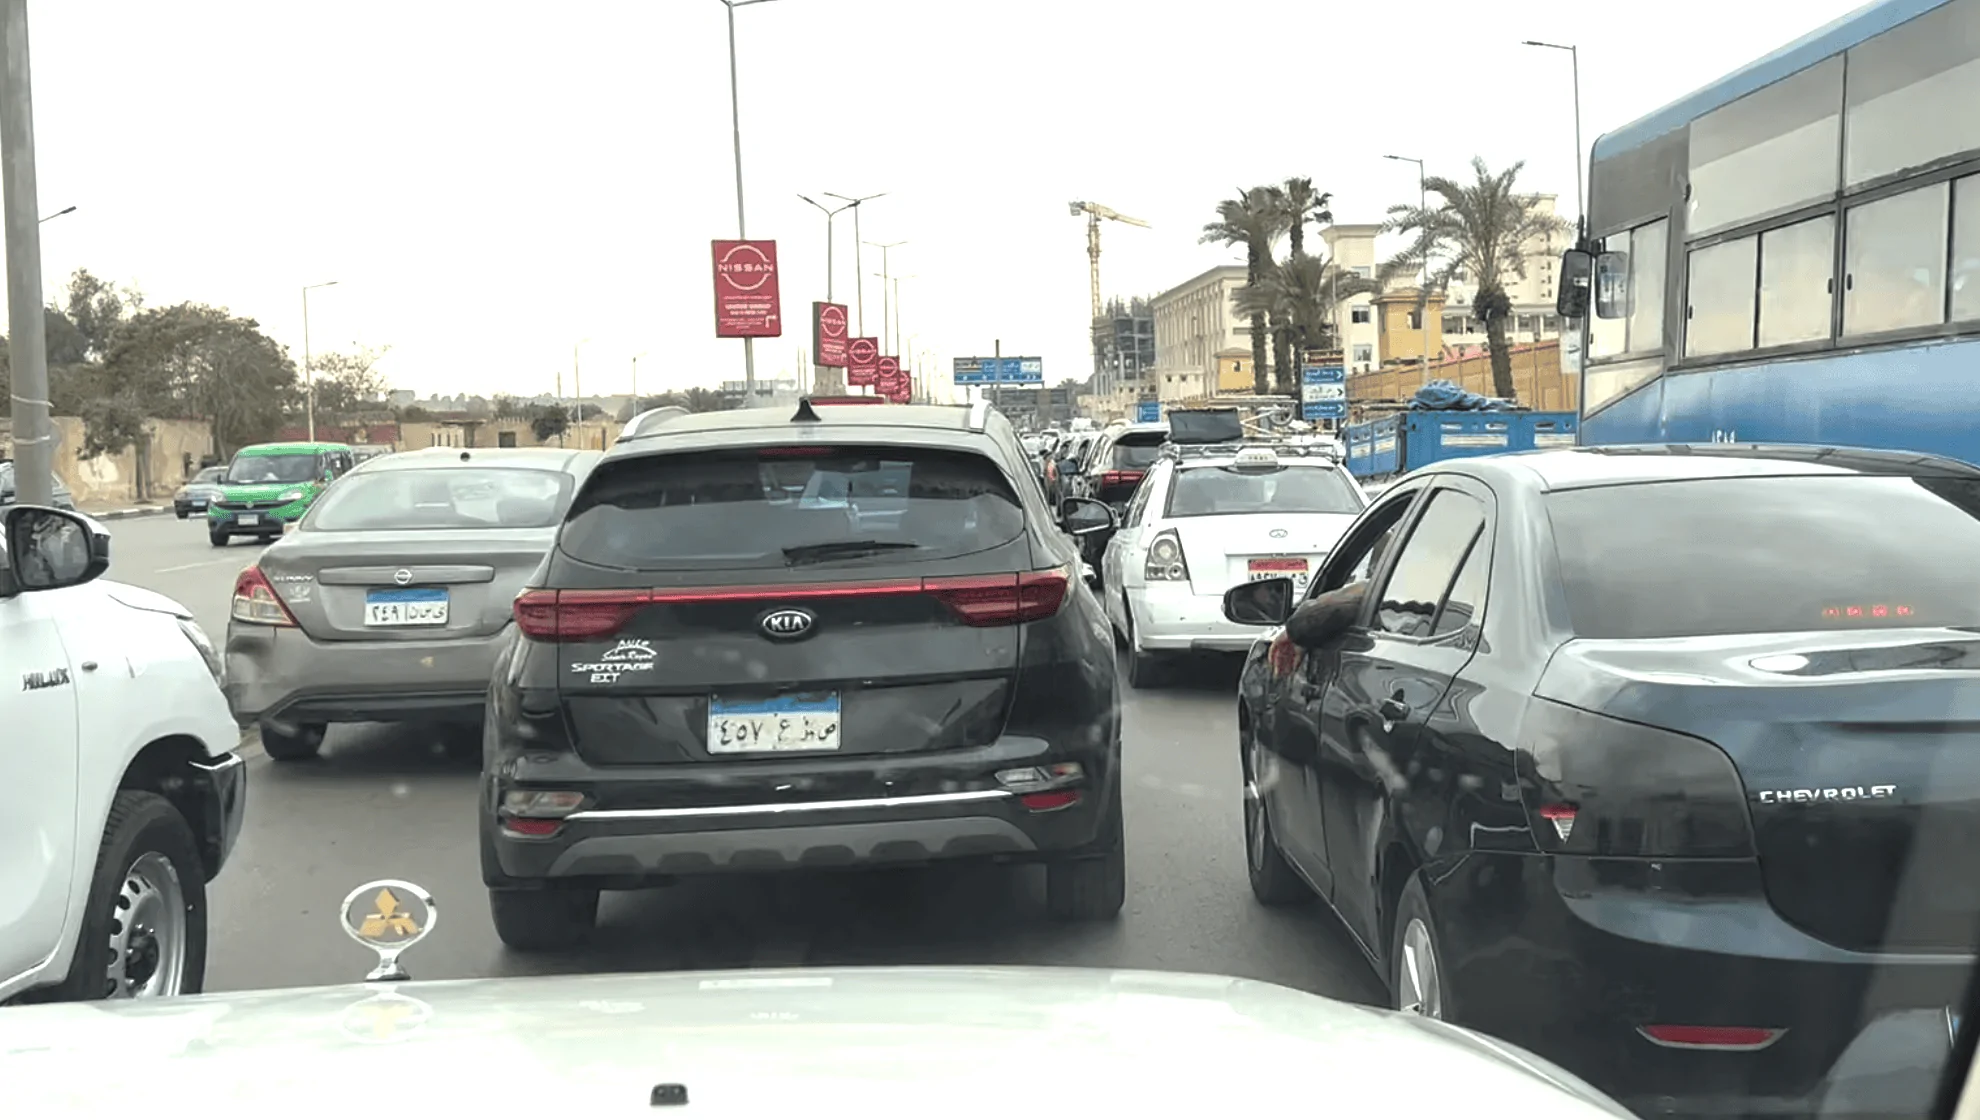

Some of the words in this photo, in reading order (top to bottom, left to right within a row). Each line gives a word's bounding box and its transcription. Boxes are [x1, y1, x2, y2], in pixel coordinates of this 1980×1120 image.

[718, 263, 774, 273] NISSAN
[771, 615, 804, 631] KIA
[571, 662, 655, 673] SPORTAGE
[22, 667, 71, 692] HILUX
[719, 719, 764, 746] ٤٥٧
[1759, 784, 1898, 804] CHEVROLET
